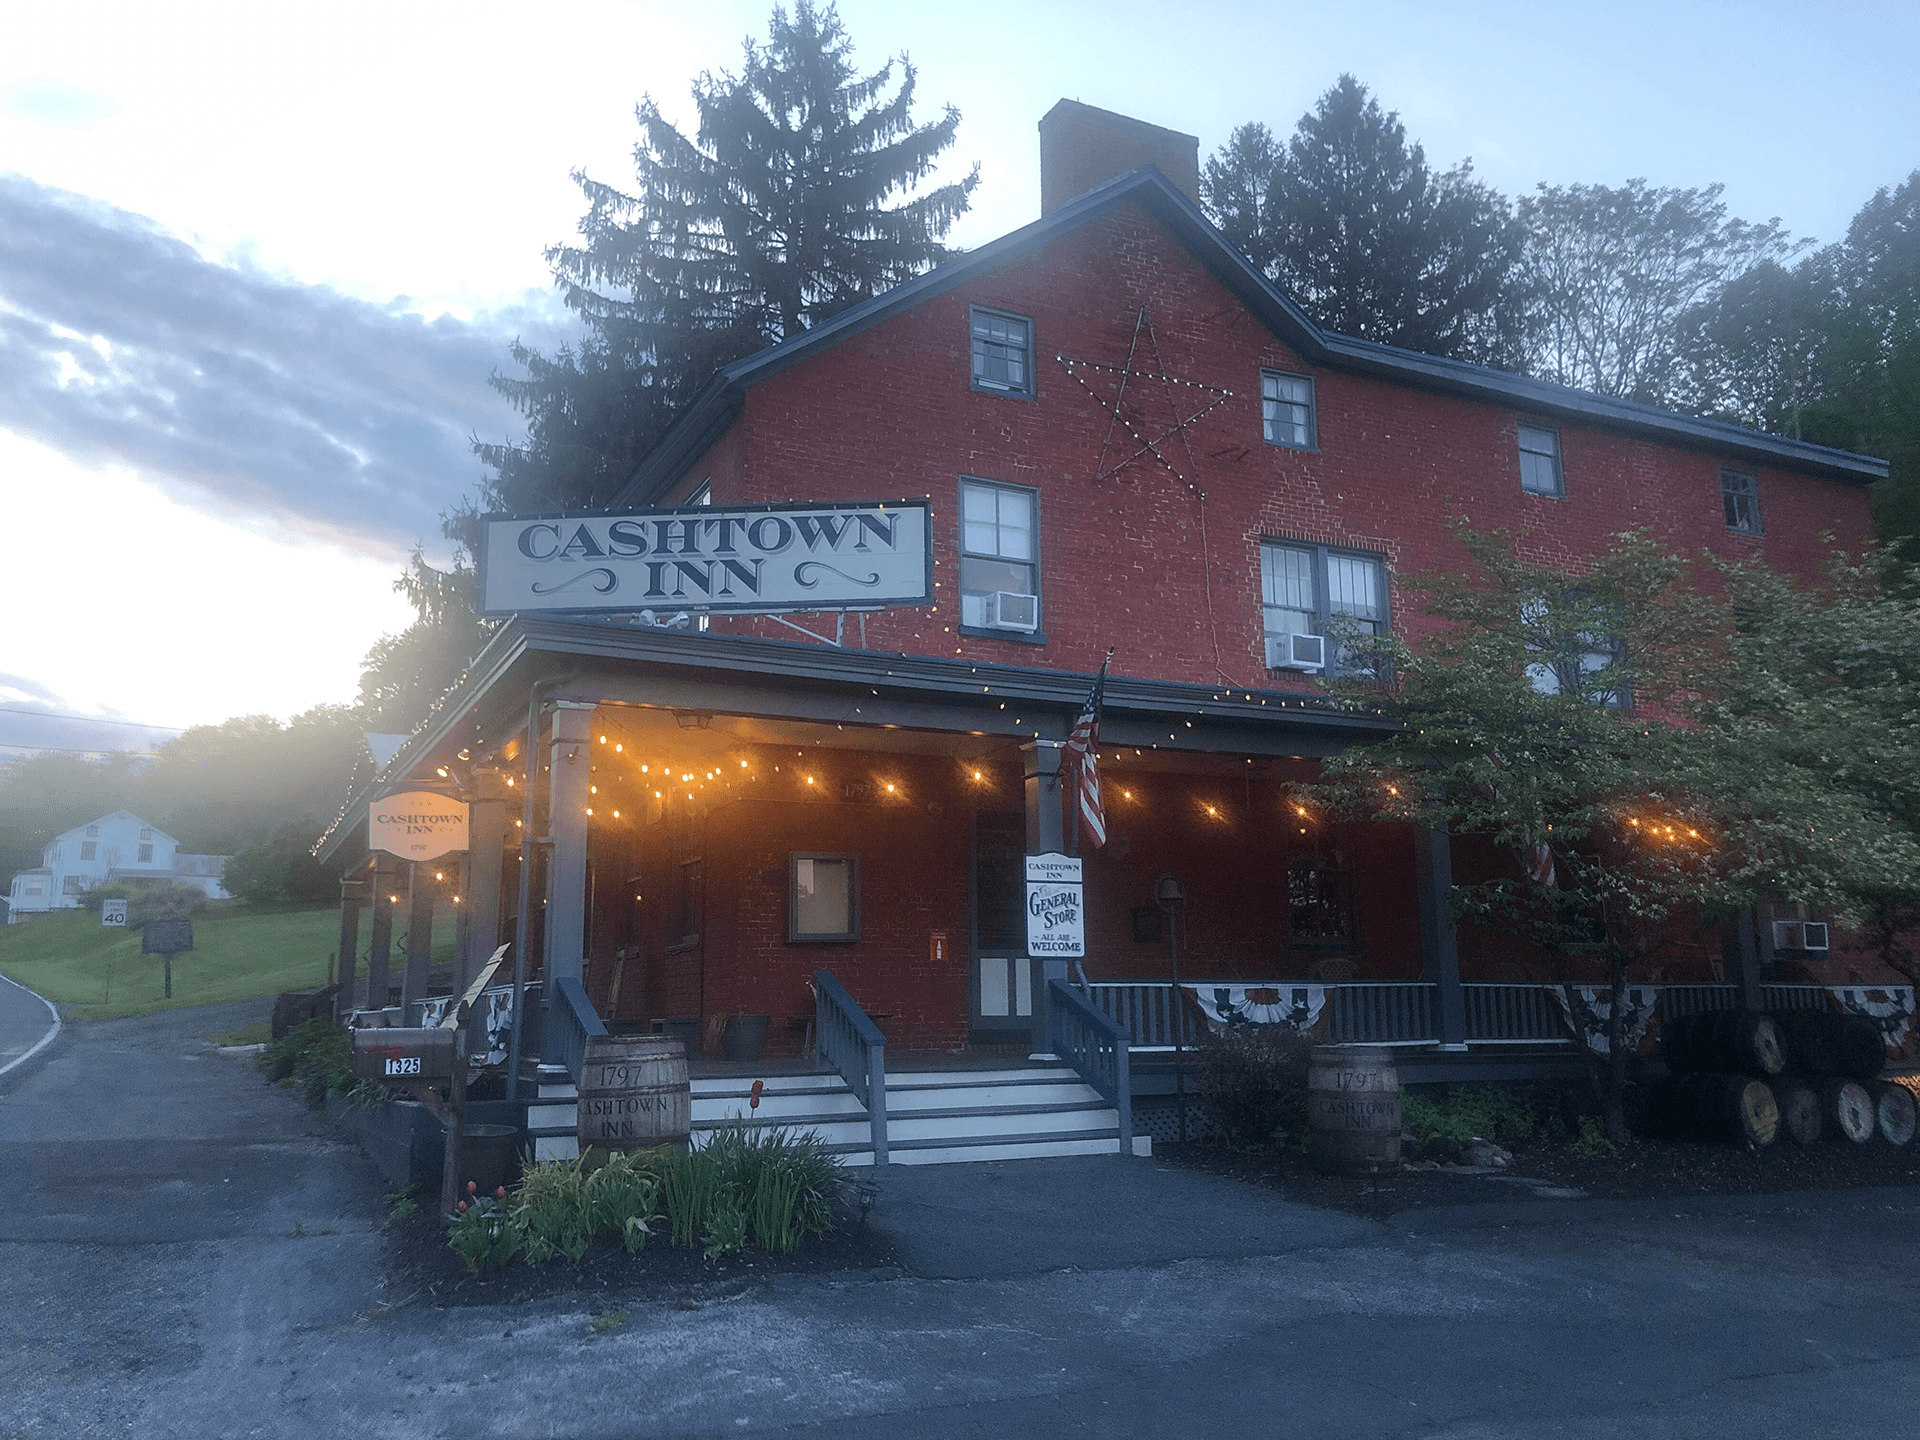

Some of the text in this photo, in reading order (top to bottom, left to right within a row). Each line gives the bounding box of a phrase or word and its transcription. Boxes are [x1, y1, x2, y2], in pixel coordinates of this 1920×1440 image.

[517, 512, 899, 561] CASHTOWN
[643, 558, 764, 598] INN
[376, 814, 463, 825] CASHTOWN
[406, 825, 434, 835] INN
[1028, 862, 1080, 872] CASHTOWN
[1046, 871, 1062, 879] INN
[1029, 891, 1080, 917] GENERAL
[104, 913, 125, 924] 40
[1044, 908, 1077, 930] STORE
[1041, 933, 1055, 941] ALL
[1031, 941, 1081, 952] WELCOME
[388, 1058, 419, 1074] 1325
[600, 1065, 642, 1087] 1797
[1336, 1072, 1377, 1089] 1797
[1319, 1100, 1395, 1115] CASHTOWN
[601, 1120, 634, 1138] INN
[1344, 1115, 1372, 1129] INN
